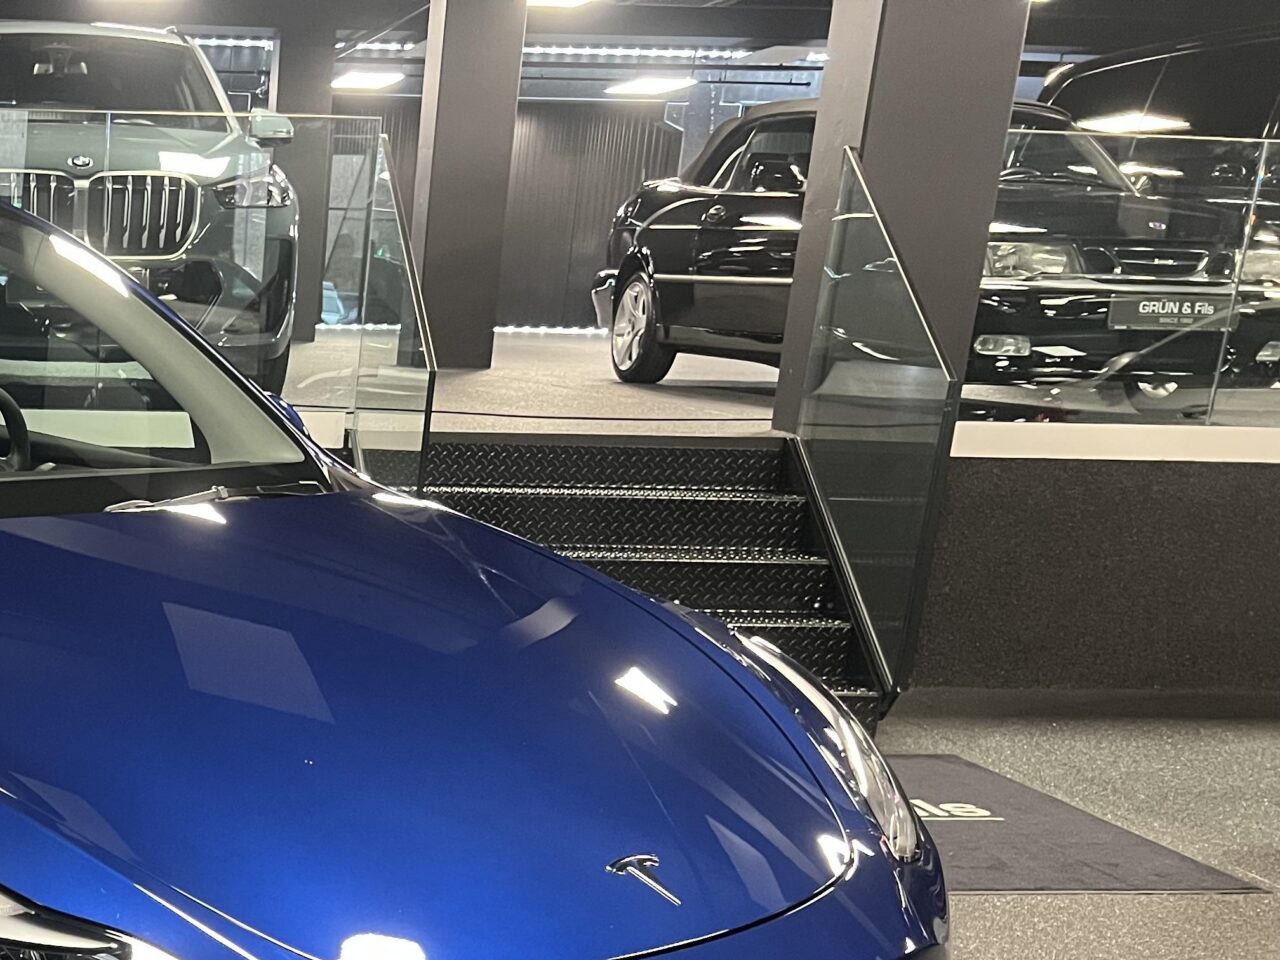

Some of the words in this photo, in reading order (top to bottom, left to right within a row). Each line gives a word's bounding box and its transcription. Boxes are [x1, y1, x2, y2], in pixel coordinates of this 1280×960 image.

[1139, 299, 1179, 314] GRÜN
[1181, 302, 1192, 314] &
[1194, 302, 1214, 315] Fils
